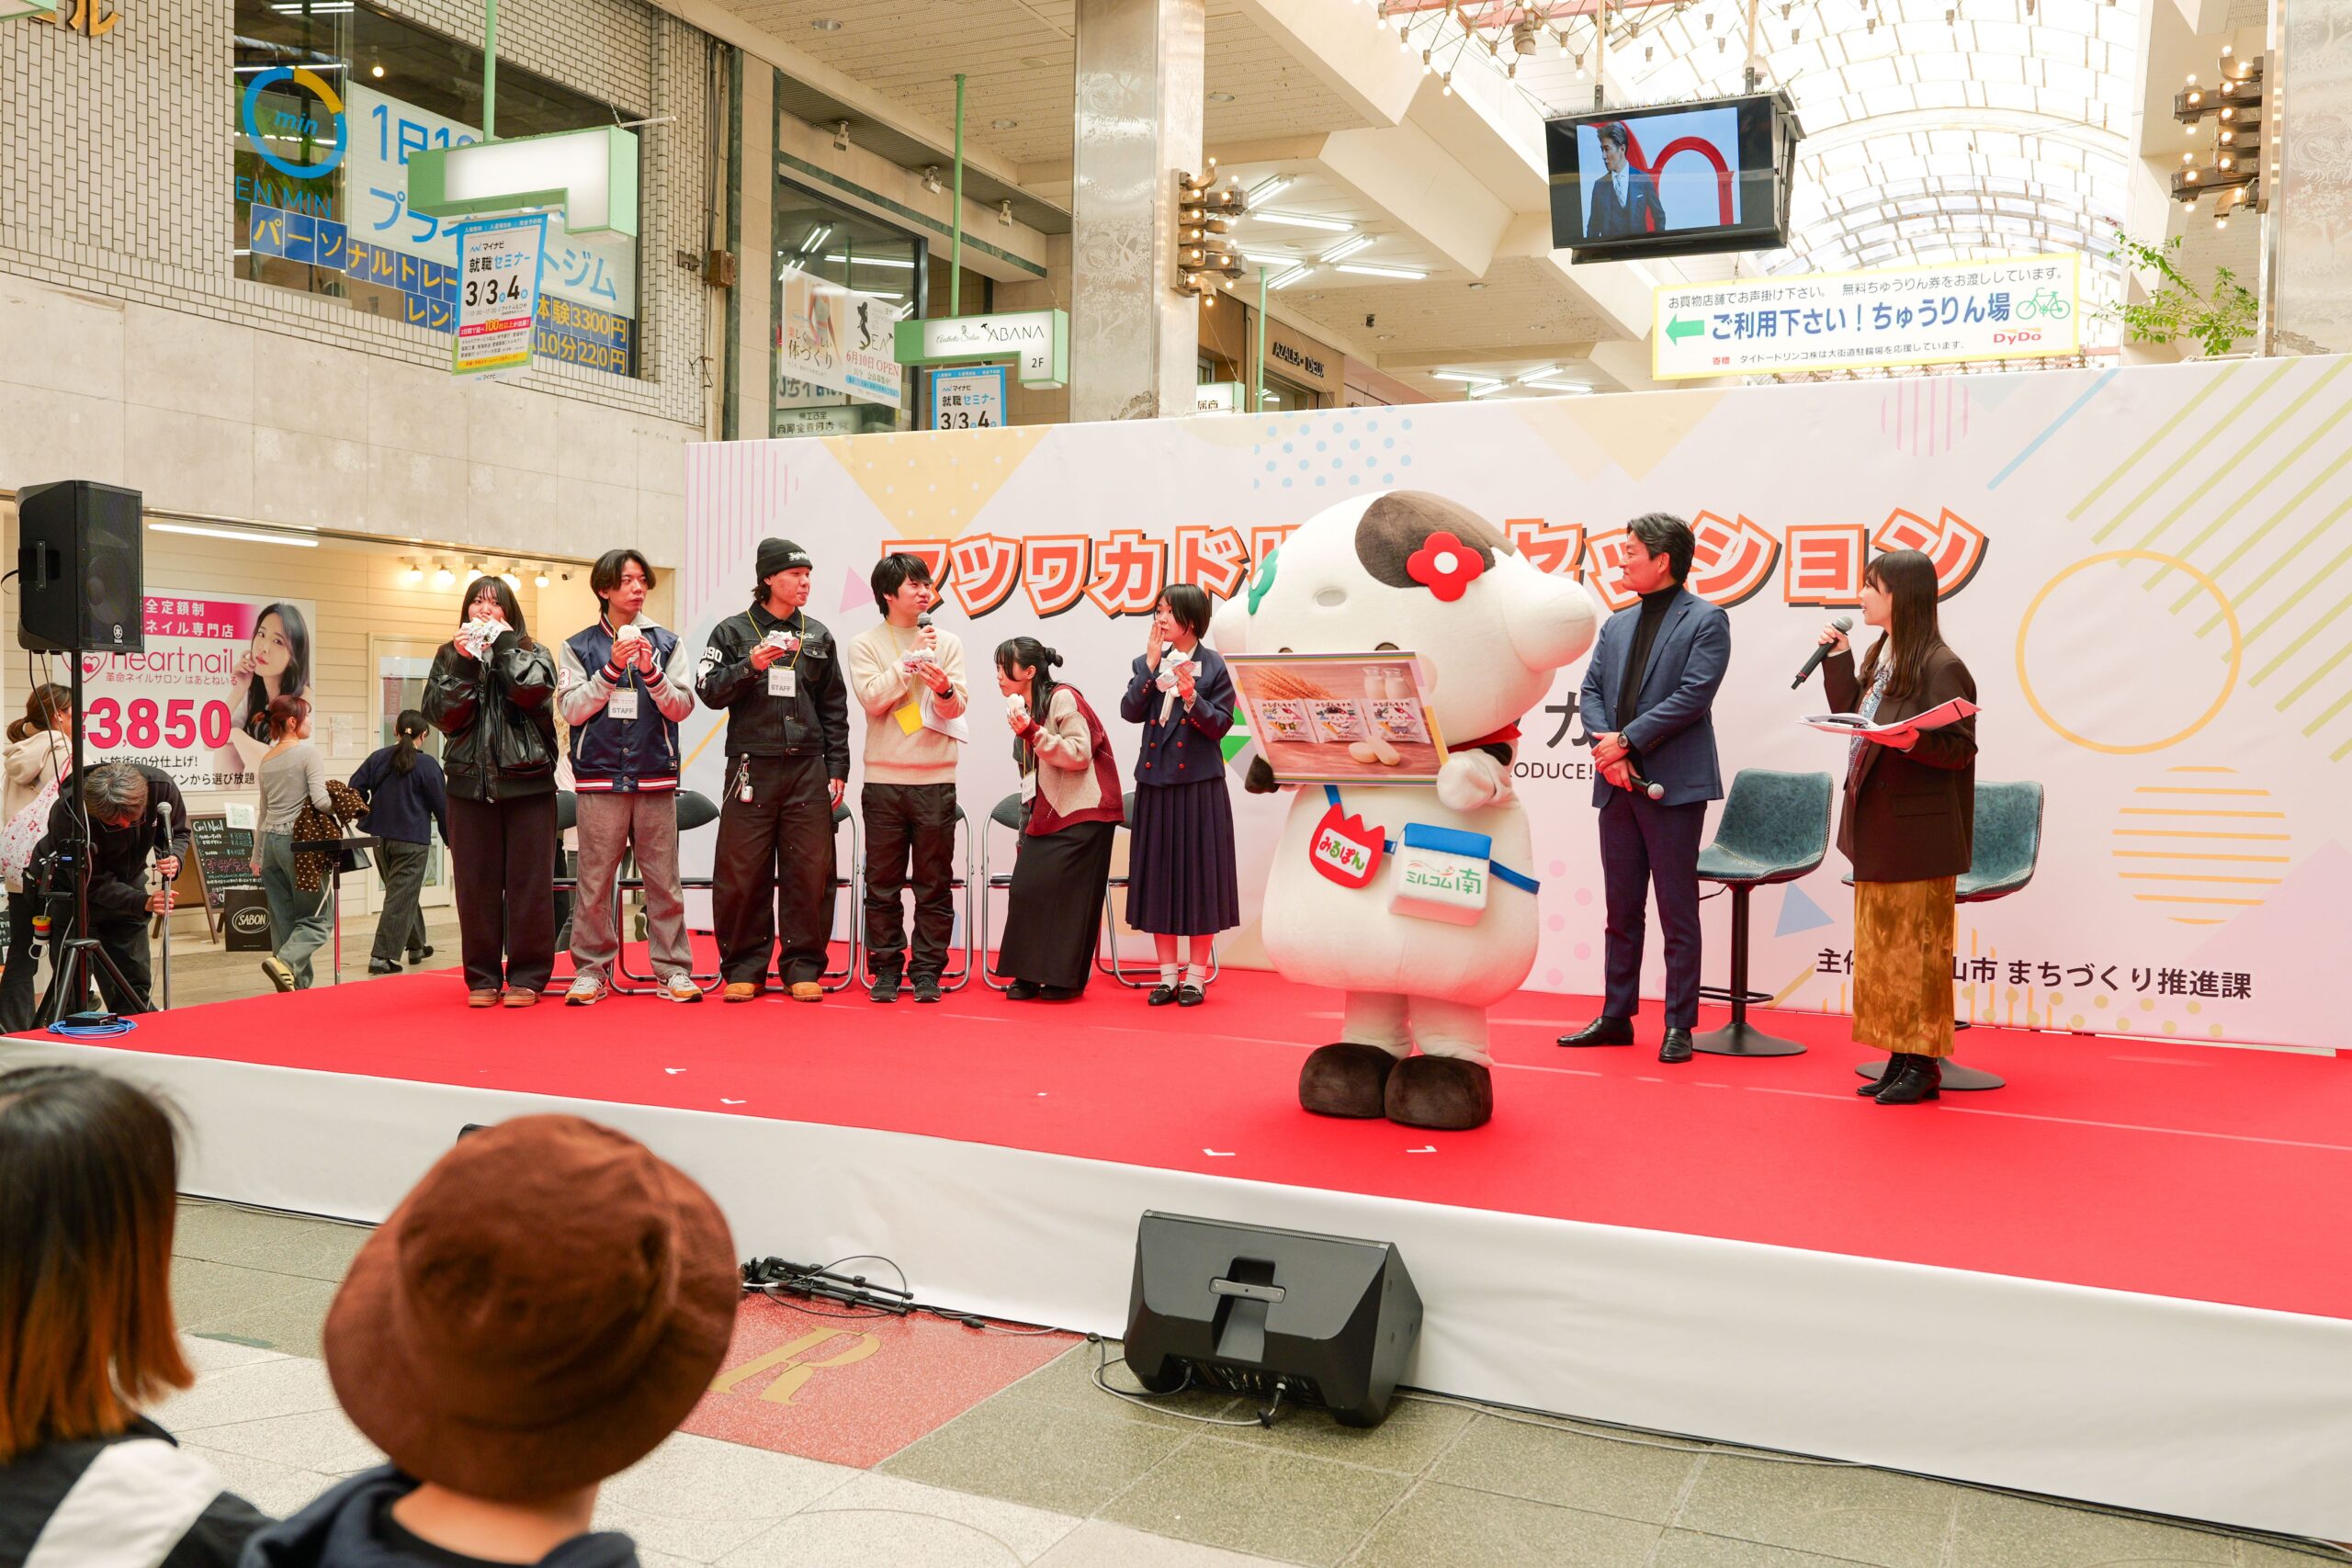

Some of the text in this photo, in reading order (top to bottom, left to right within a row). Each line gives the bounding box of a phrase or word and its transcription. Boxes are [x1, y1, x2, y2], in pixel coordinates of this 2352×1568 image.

[275, 109, 319, 135] min
[281, 186, 333, 220] MIN
[482, 241, 504, 251] マイナビ
[469, 251, 531, 274] 就職セミナー
[1668, 266, 2063, 310] お買物店舗でお声掛け下さい。 無料ちゅうりん券をお渡ししています。
[408, 298, 457, 327] レン
[1993, 332, 2042, 345] DyDo
[533, 332, 626, 375] 10分220円
[788, 339, 832, 369] 体づくり
[846, 350, 874, 369] 6月10日
[876, 359, 899, 377] OPEN
[1031, 357, 1045, 367] 2F
[942, 393, 996, 407] 就職セミナー
[145, 599, 205, 617] 全定額制
[145, 620, 234, 638] ネイル専門店
[106, 671, 238, 686] 革命ネイルサロン はあとねいる
[771, 683, 792, 693] STAFF
[83, 697, 232, 749] 3,850
[1510, 762, 1593, 780] ODUCE!
[208, 820, 224, 832] Nail
[1318, 836, 1365, 871] みるぽん
[238, 914, 266, 926] SABON
[2007, 960, 2252, 999] まちづくり推進課
[707, 1325, 881, 1405] R
